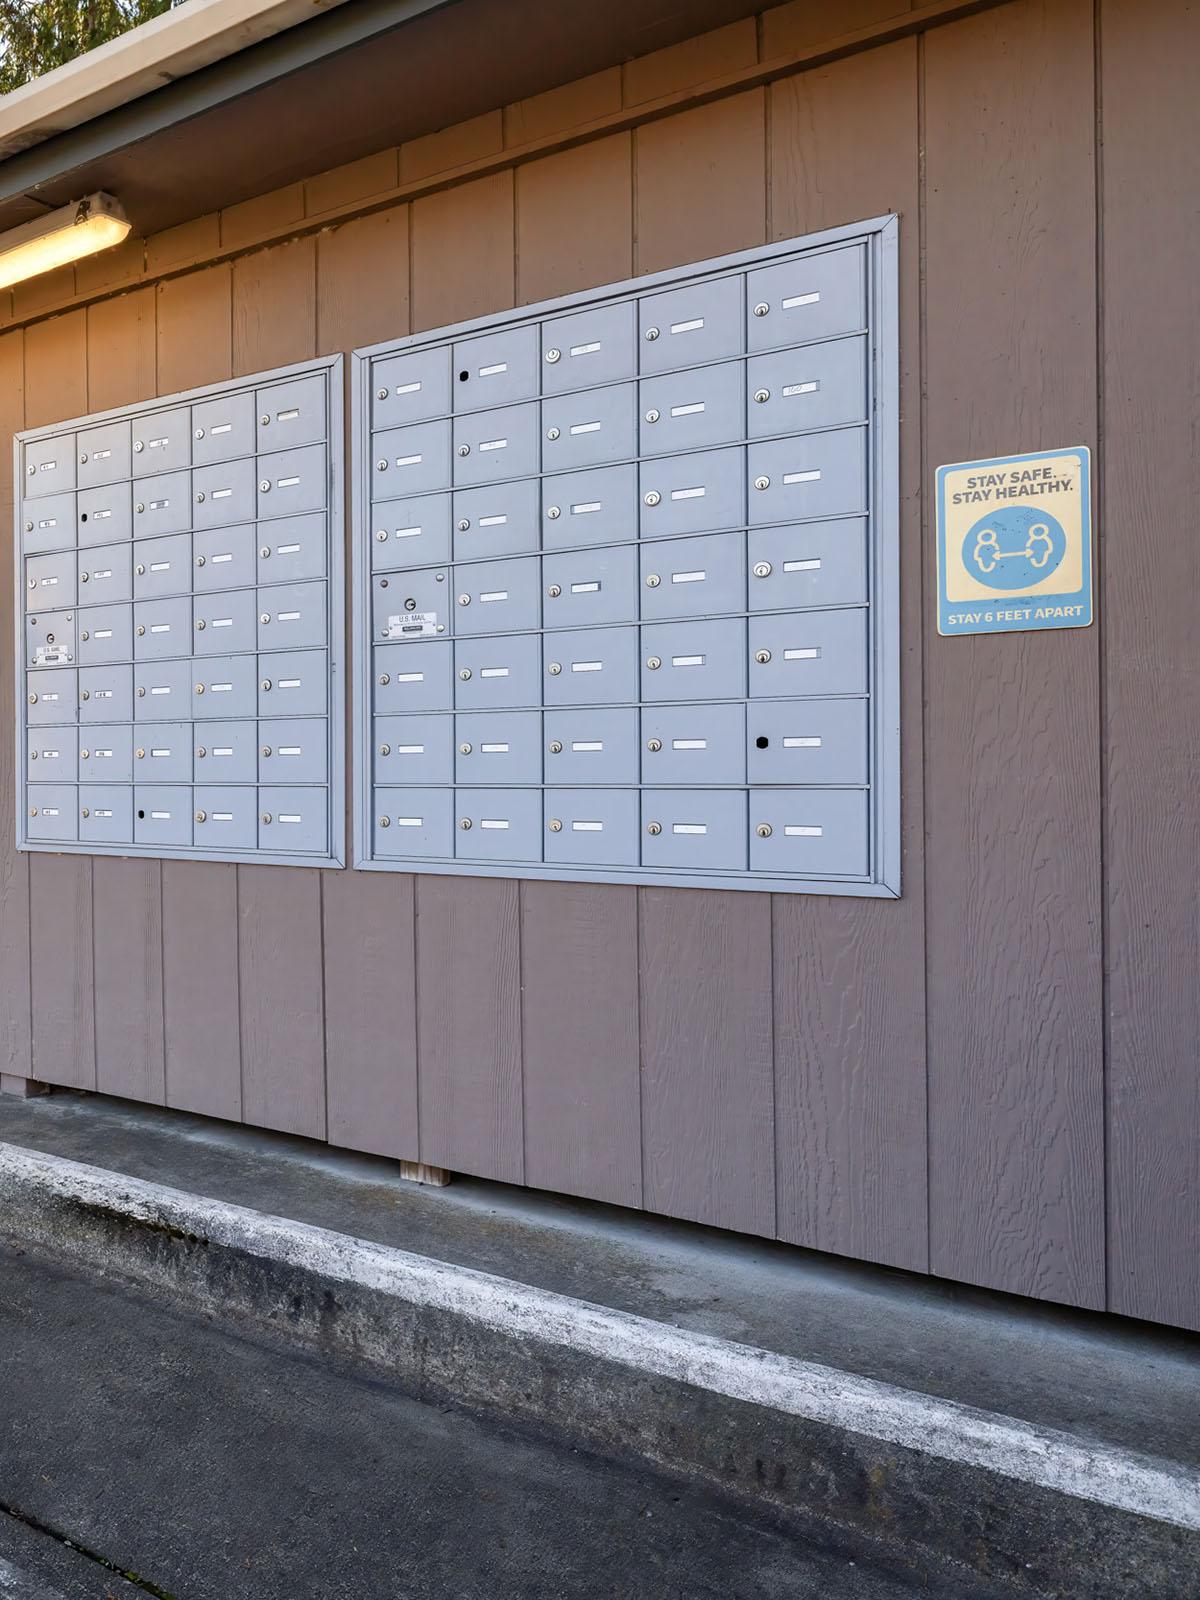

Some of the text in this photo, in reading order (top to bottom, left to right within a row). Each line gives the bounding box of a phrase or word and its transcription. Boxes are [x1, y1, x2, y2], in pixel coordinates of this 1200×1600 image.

[967, 473, 1006, 489] STAY
[952, 479, 1073, 505] STAY HEALTHY.
[948, 605, 1084, 625] STAY 6 FEET APART
